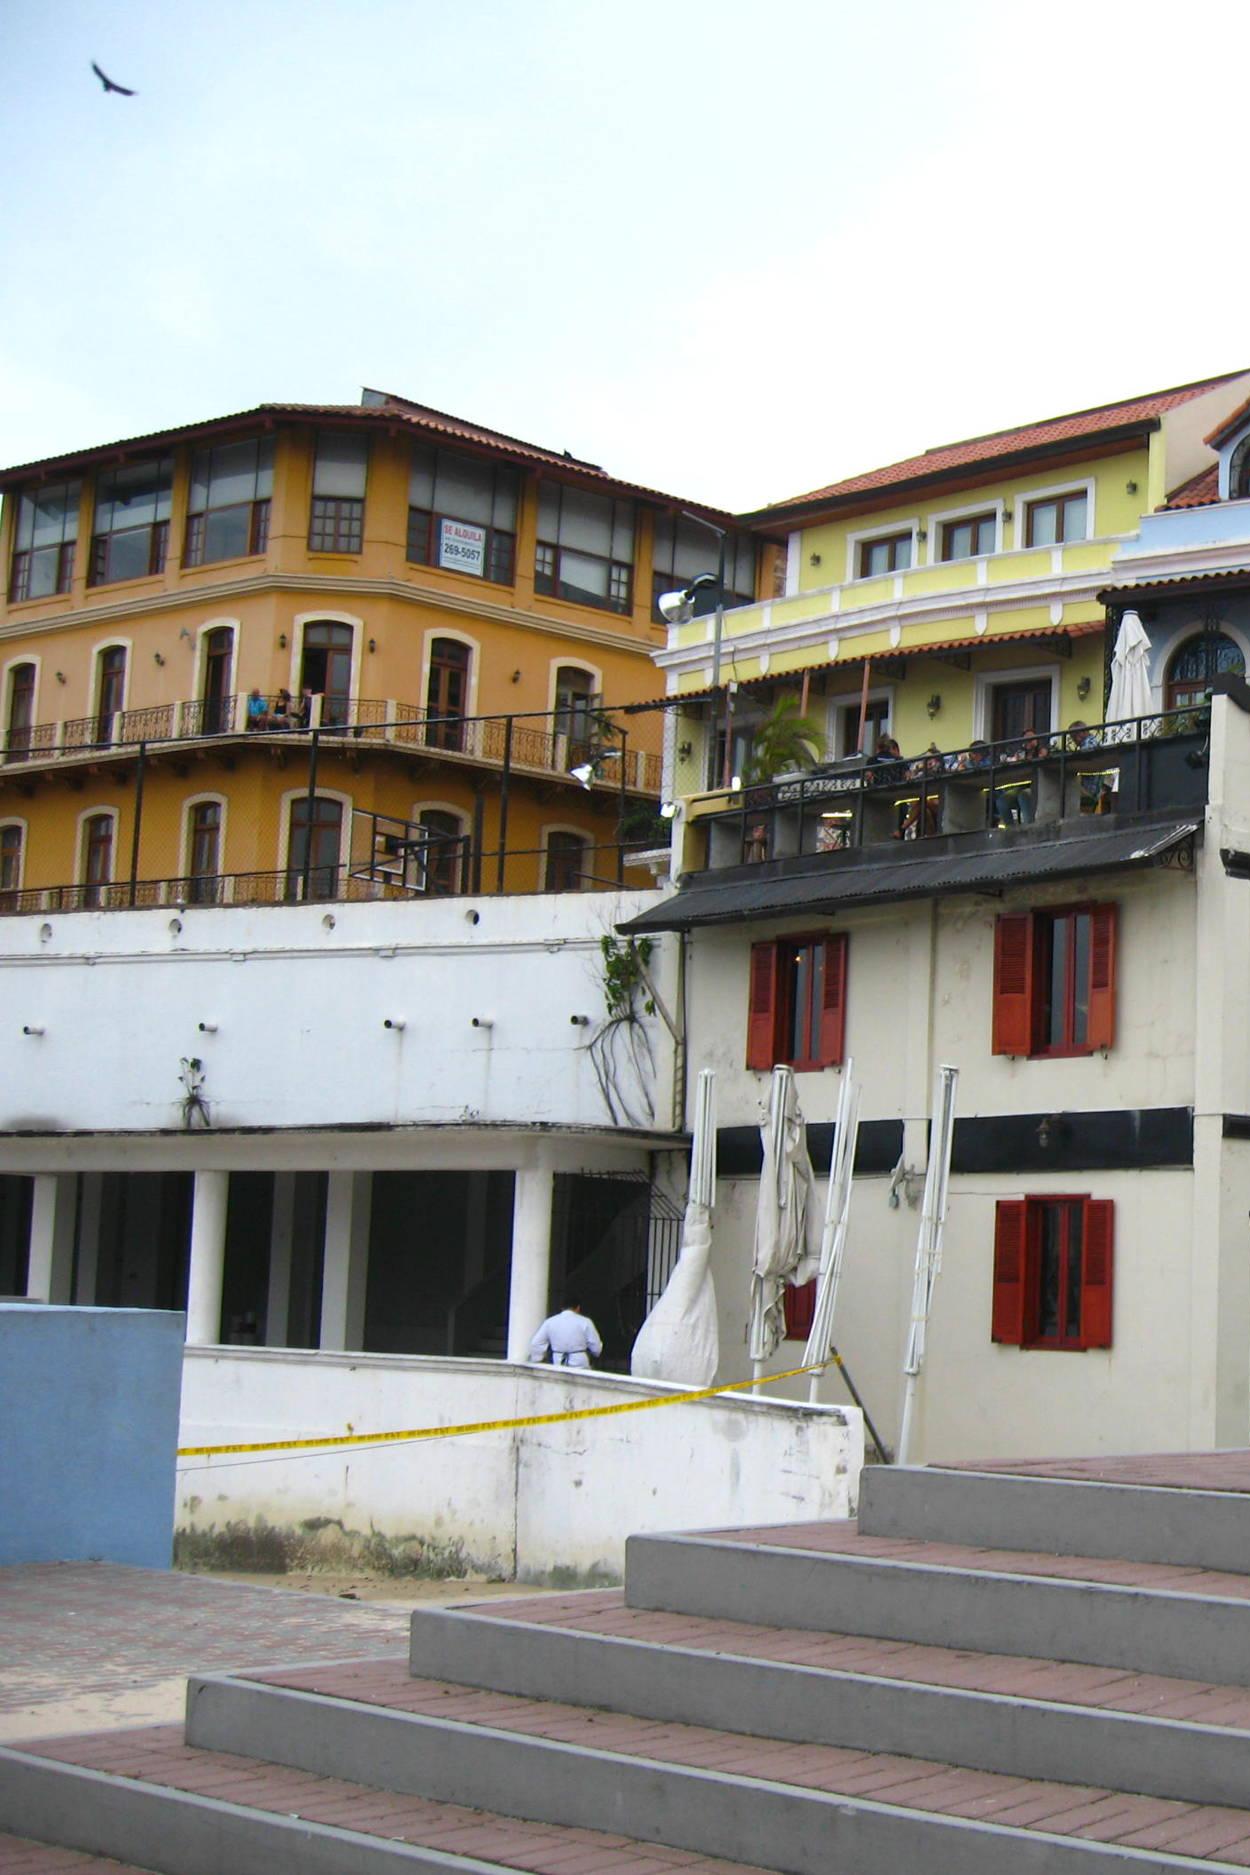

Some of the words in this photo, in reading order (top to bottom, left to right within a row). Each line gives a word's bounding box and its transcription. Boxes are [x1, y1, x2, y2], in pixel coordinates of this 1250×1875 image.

[444, 524, 453, 535] SE
[454, 526, 482, 542] ALQUILA
[444, 543, 481, 561] 269-5057
